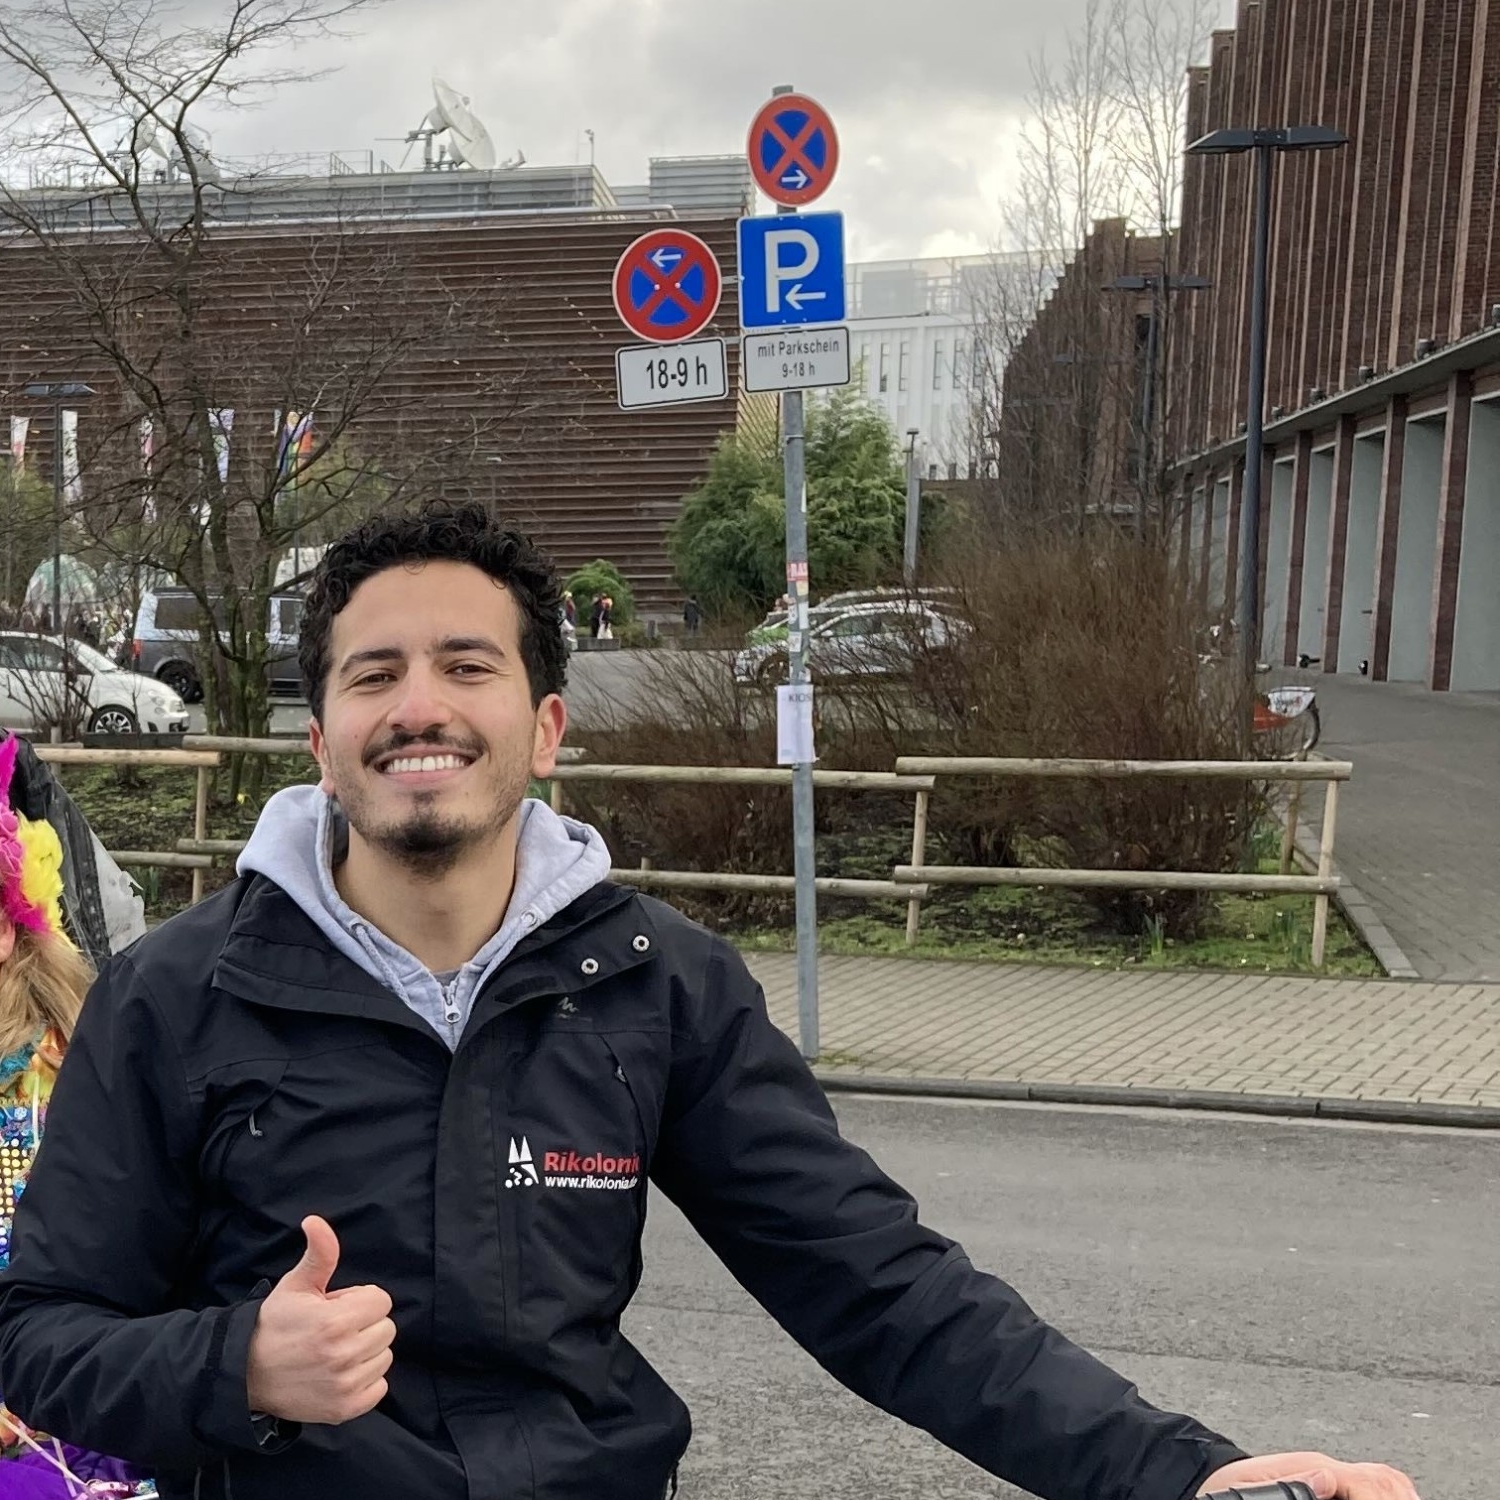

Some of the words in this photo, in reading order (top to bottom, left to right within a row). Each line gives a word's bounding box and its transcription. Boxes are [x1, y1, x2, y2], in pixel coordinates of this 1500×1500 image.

[763, 228, 820, 313] P
[757, 344, 775, 357] mit
[778, 338, 839, 355] Parkschein
[645, 357, 689, 389] 18-9
[696, 355, 708, 385] h
[781, 362, 805, 377] 9-18
[809, 361, 816, 375] h
